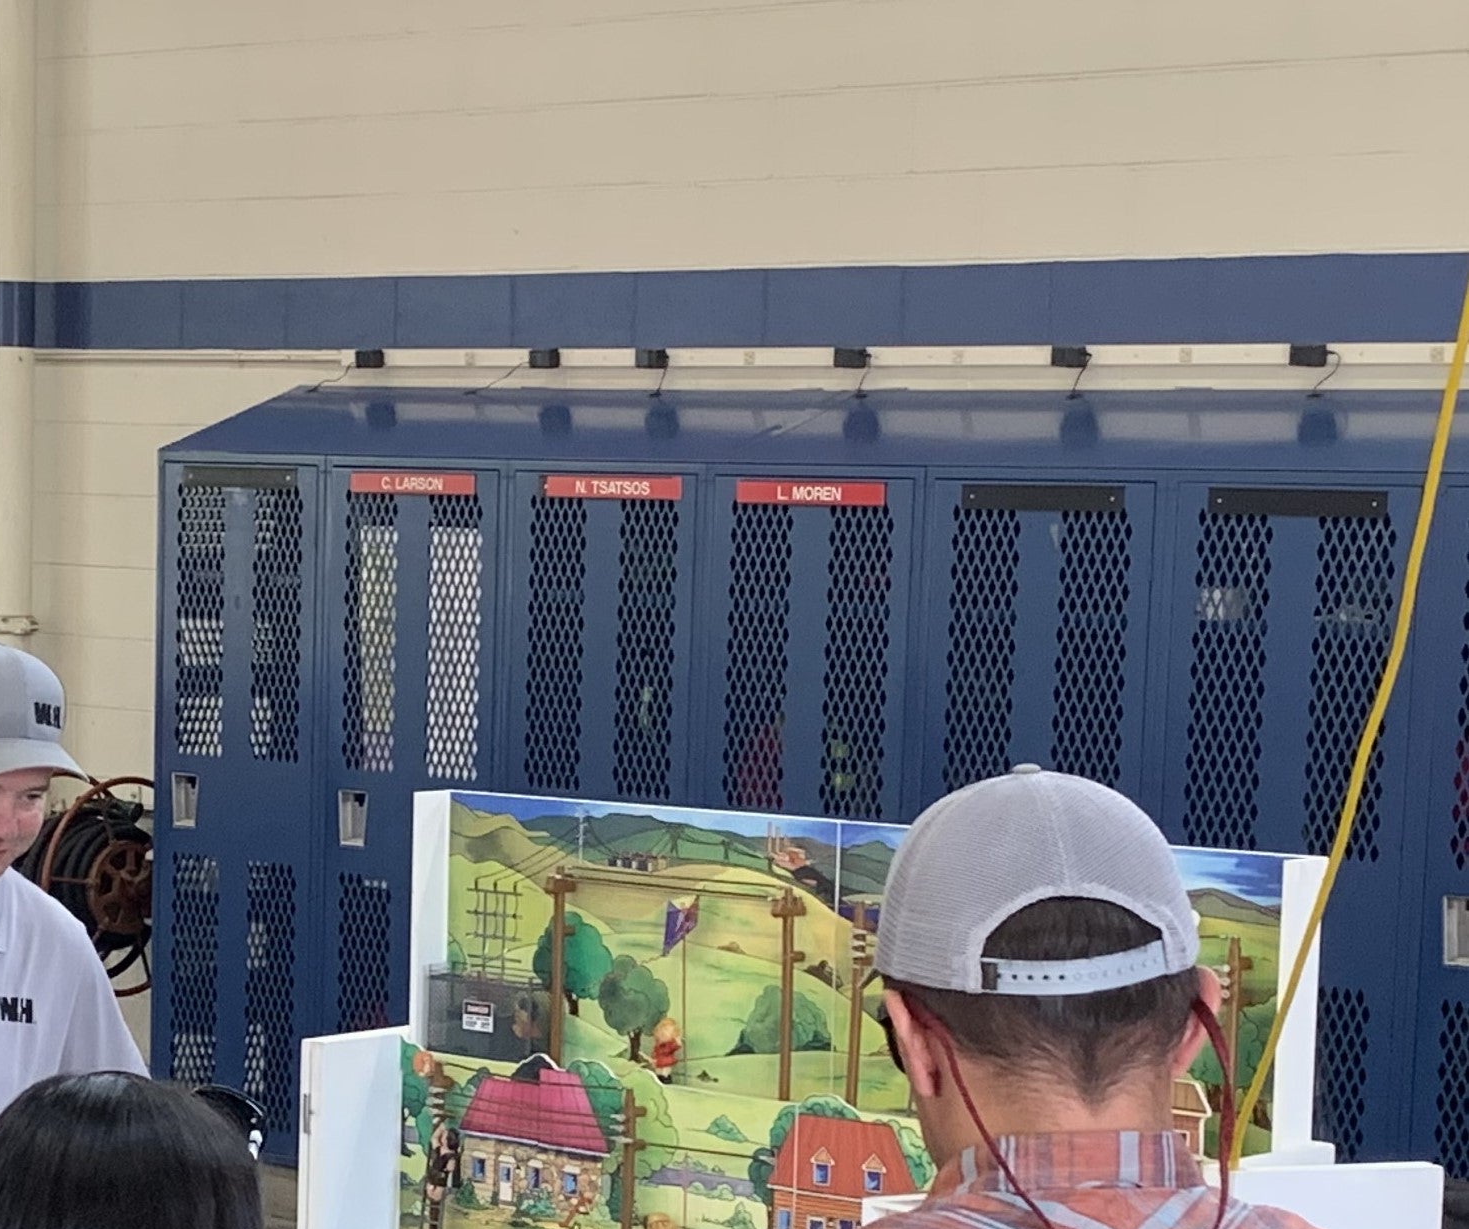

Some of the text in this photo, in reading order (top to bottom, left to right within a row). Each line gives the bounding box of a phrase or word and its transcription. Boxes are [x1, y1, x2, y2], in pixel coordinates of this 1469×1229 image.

[381, 477, 443, 491] C. LARSON
[591, 480, 651, 495] TSATSOS
[792, 486, 842, 501] MOREN
